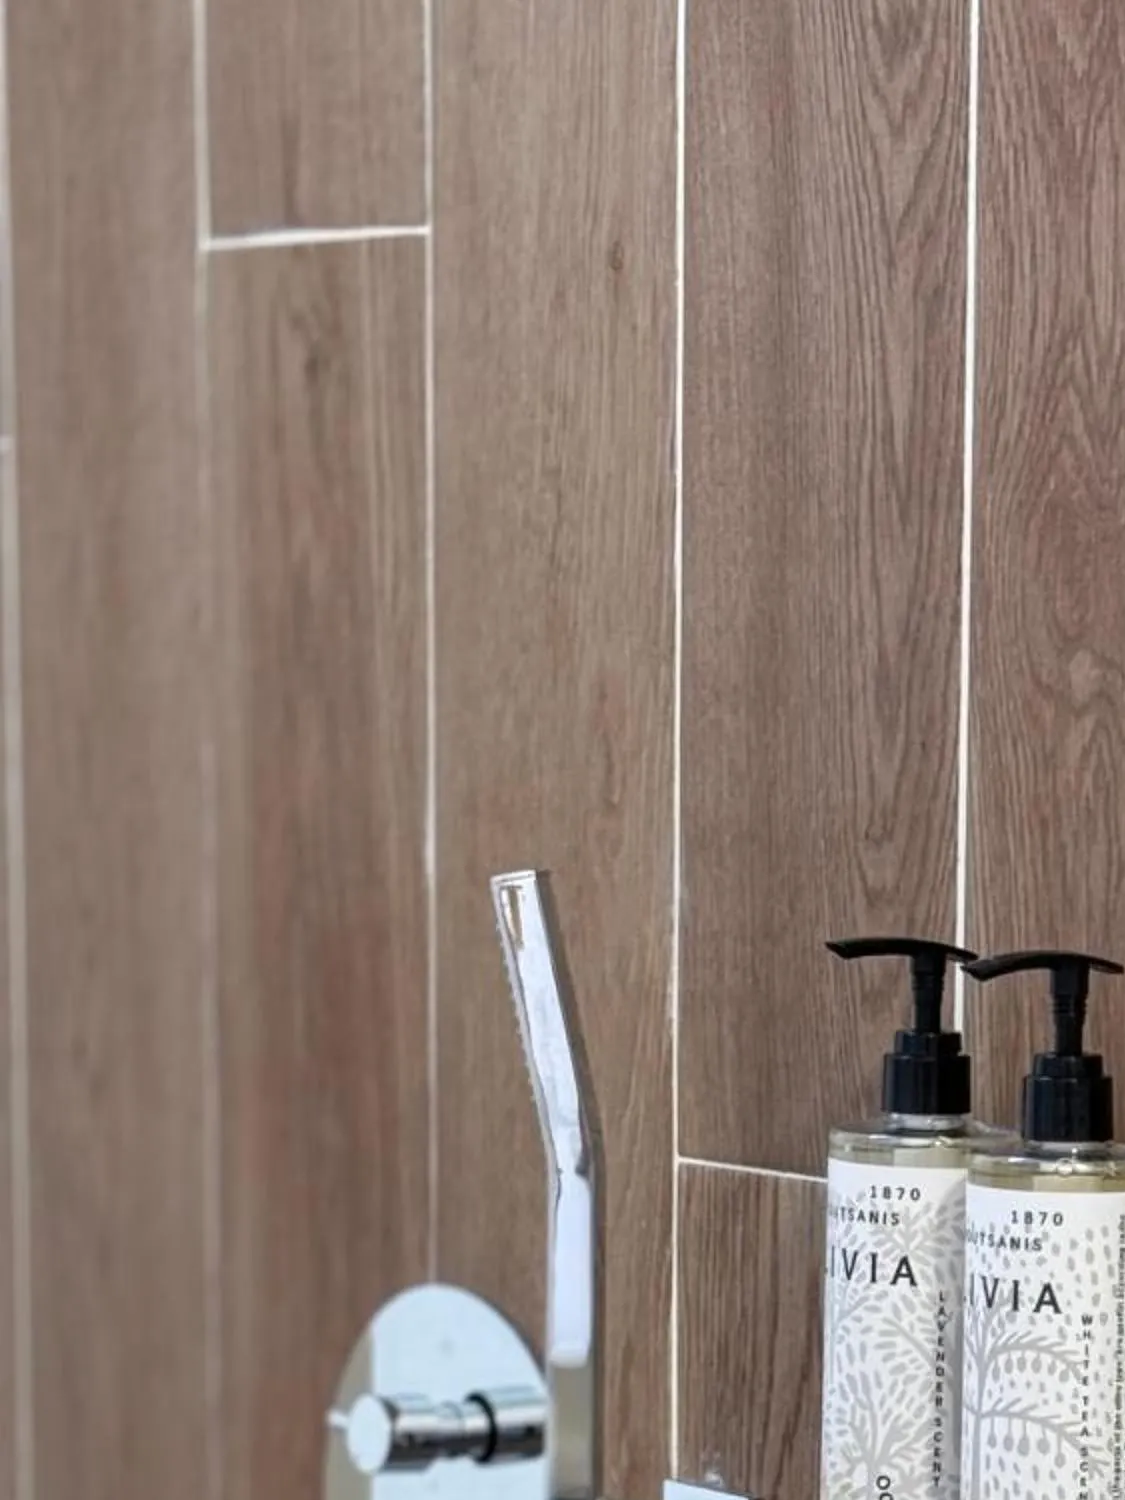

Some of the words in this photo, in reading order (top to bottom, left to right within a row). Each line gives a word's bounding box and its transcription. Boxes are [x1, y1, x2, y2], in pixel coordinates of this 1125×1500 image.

[869, 1185, 921, 1201] 1870
[1011, 1210, 1064, 1227] 1870
[1081, 1314, 1093, 1387] WHITE
[1080, 1395, 1089, 1437] TEA
[932, 1417, 944, 1488] SCENT
